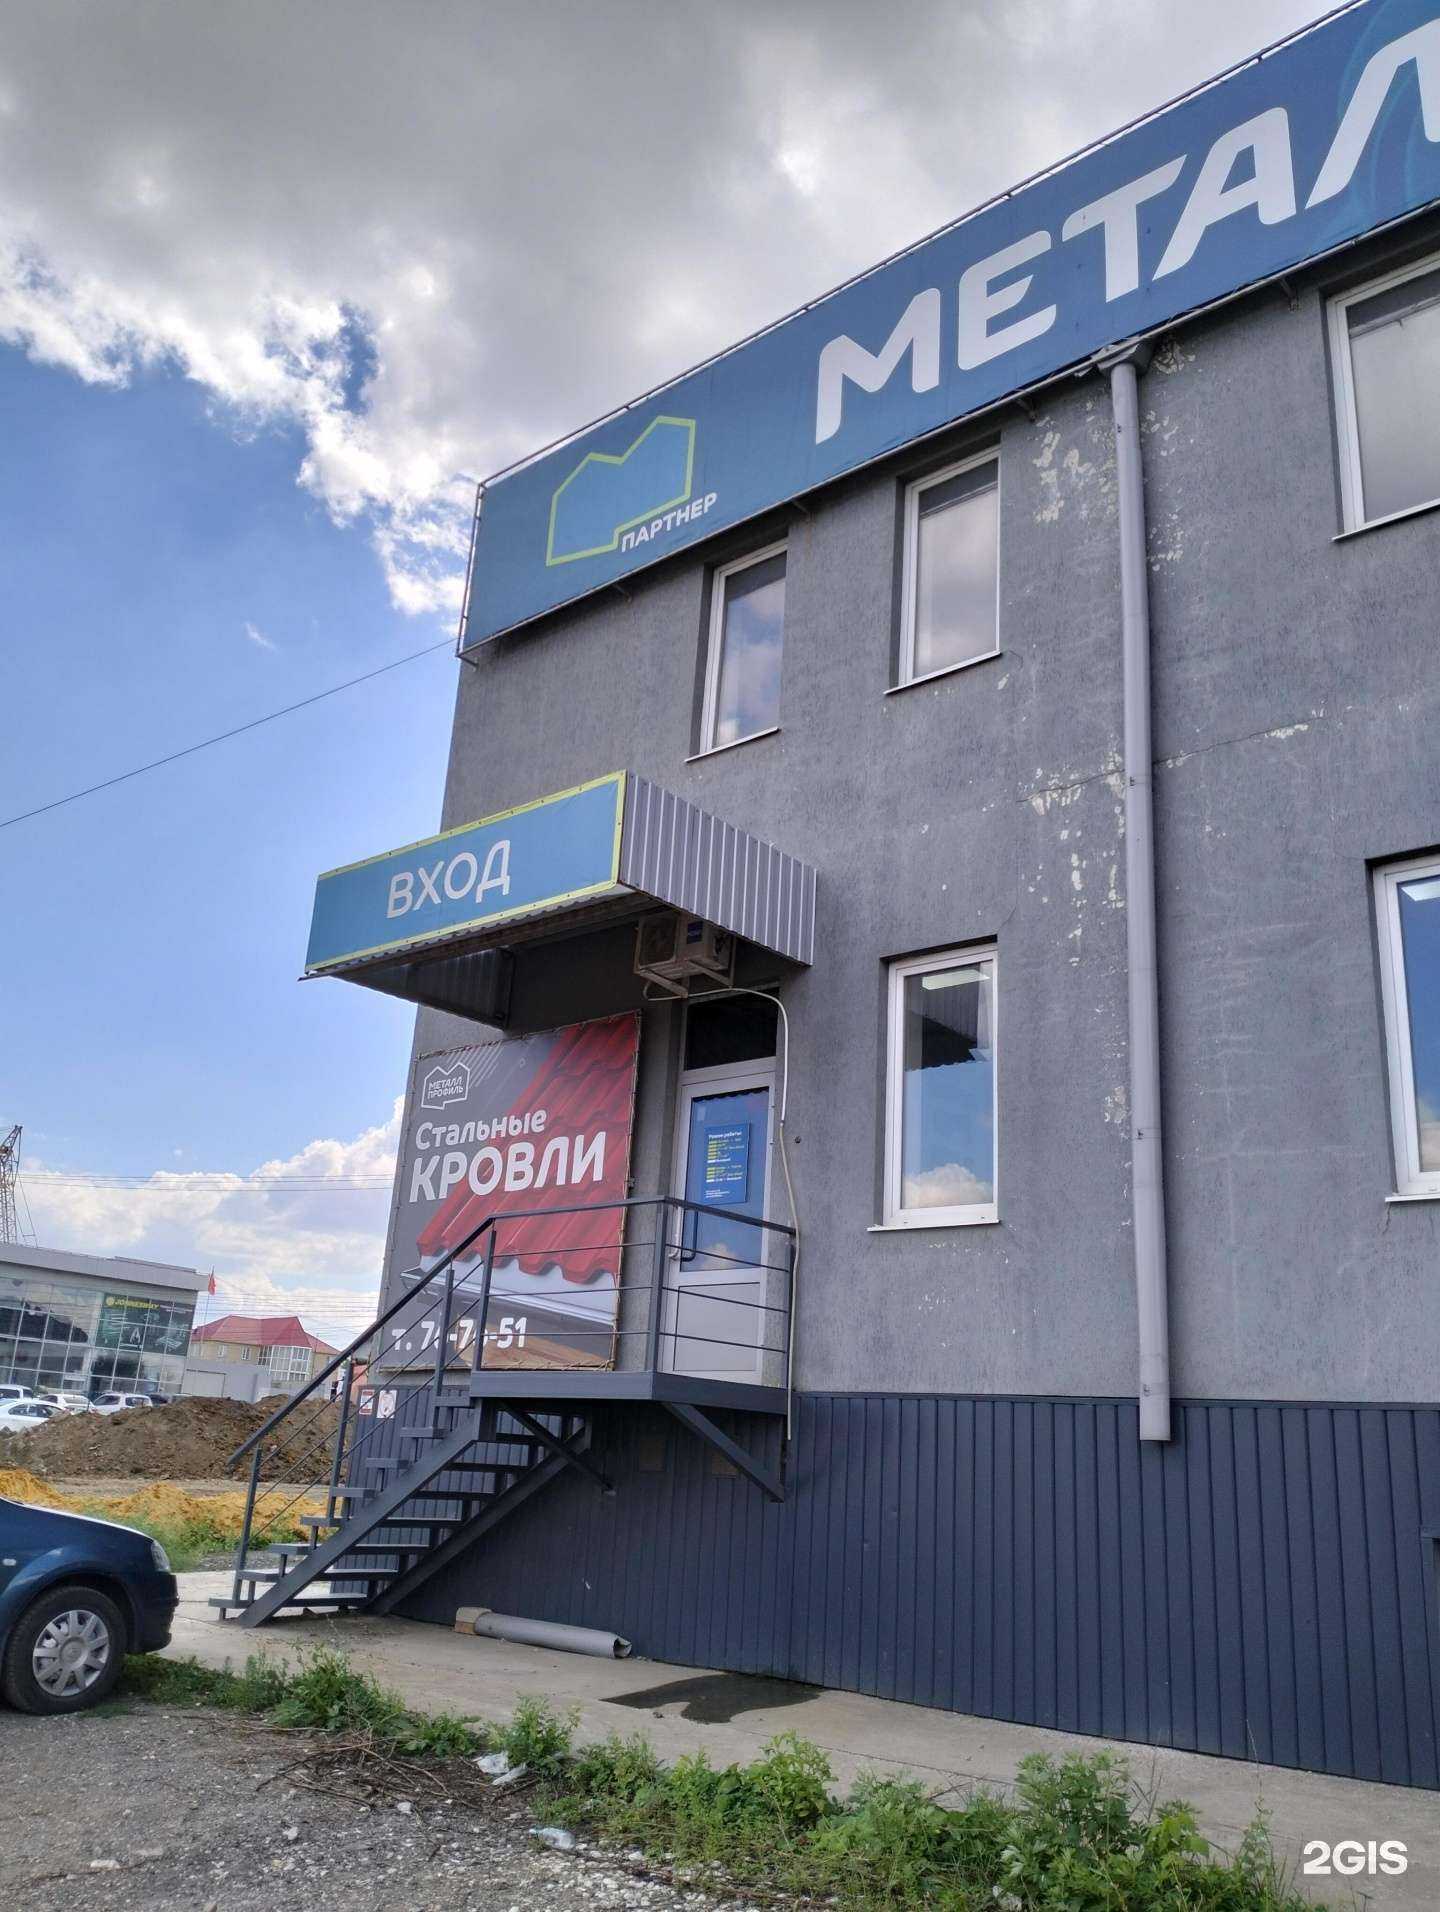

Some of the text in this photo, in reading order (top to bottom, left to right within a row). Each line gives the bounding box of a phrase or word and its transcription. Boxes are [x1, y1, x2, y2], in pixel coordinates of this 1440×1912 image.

[815, 18, 1440, 446] МЕТАЛ
[621, 492, 718, 553] ПАРТНЕР
[386, 839, 511, 919] ВХОД
[427, 1086, 465, 1100] ПРОФИЛЬ
[428, 1076, 463, 1092] МЕТАЛЛ
[415, 1109, 548, 1150] Стальные
[409, 1131, 607, 1203] КРОВЛИ
